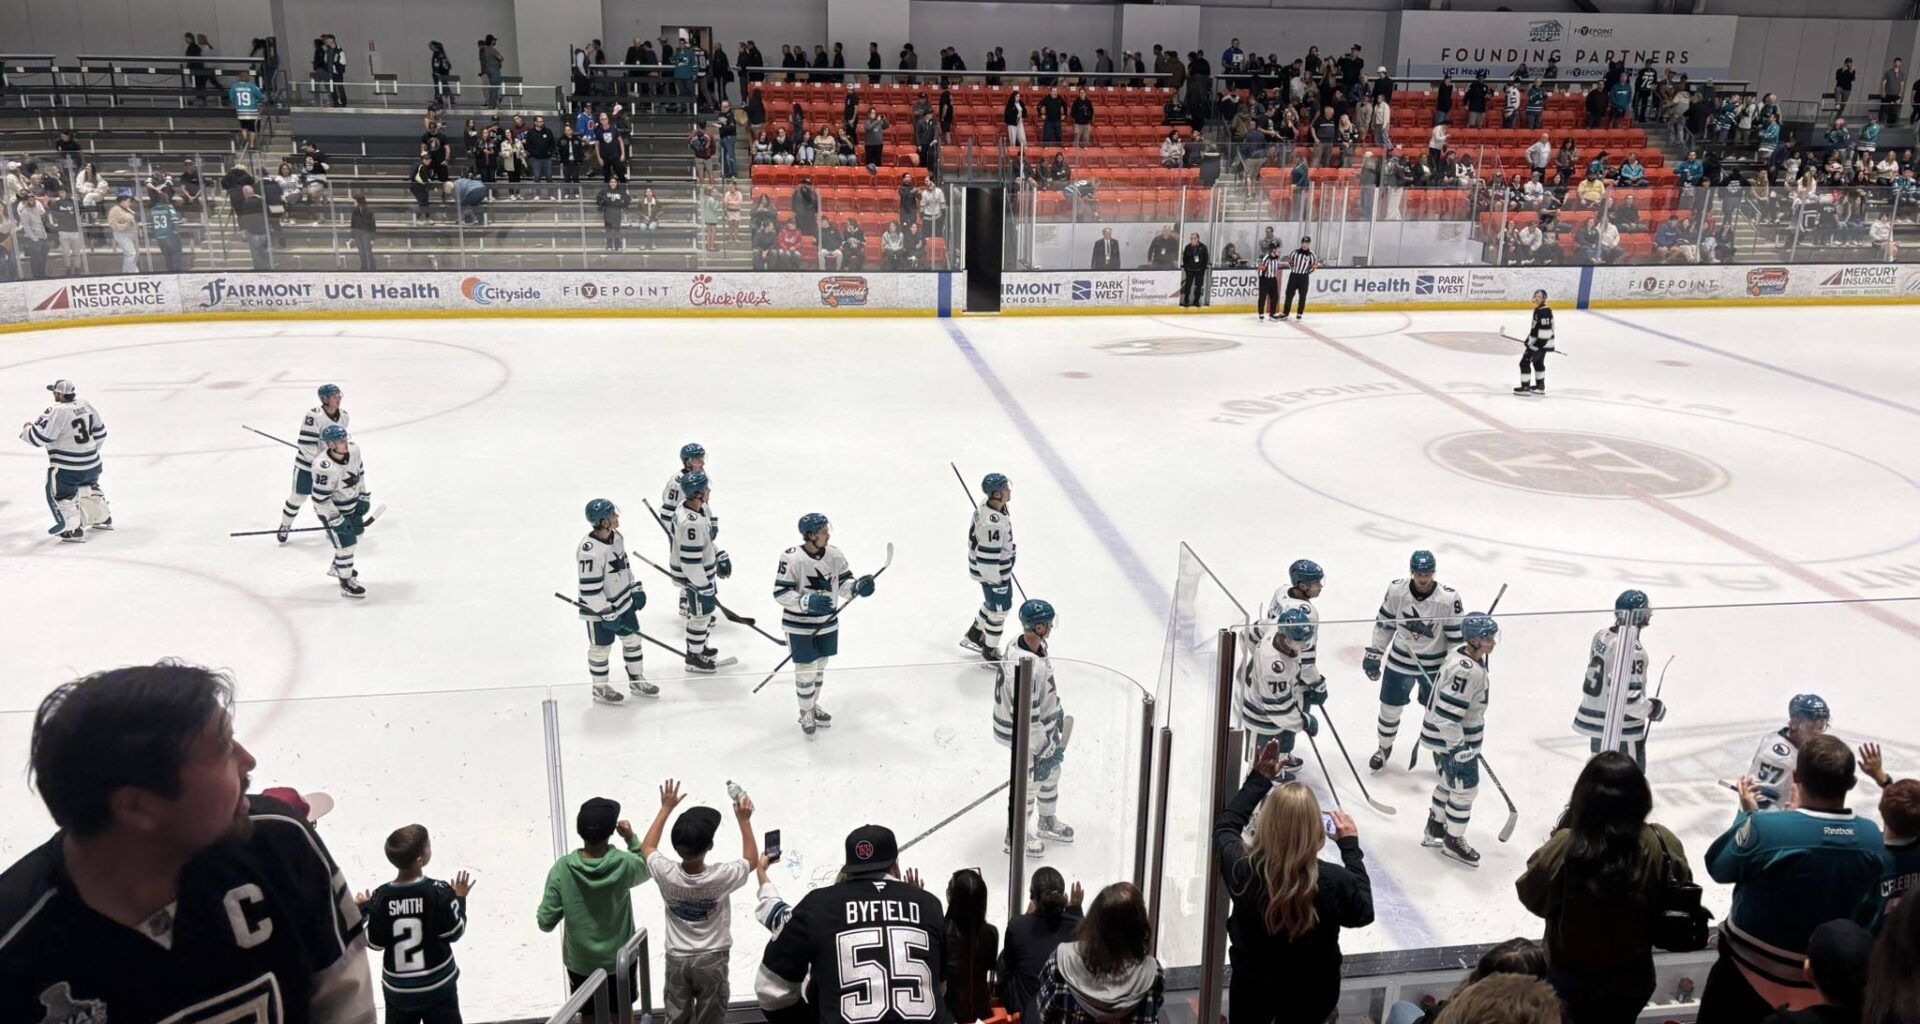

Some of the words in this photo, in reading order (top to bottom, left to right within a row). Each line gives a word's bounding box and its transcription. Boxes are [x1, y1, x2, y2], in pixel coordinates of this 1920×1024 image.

[1441, 47, 1562, 64] FOUNDING
[1576, 49, 1690, 64] PARTNERS
[1442, 67, 1458, 75] UCI
[1641, 76, 1654, 88] 72
[236, 92, 251, 106] 19
[153, 215, 168, 229] 53
[1472, 273, 1494, 281] Shaping
[1843, 266, 1898, 277] MERCURY
[1095, 280, 1123, 290] PARK
[1131, 278, 1155, 286] Shaping
[1211, 276, 1259, 288] ERCUR
[1315, 279, 1347, 293] UCI
[1354, 277, 1410, 293] Health
[1437, 275, 1465, 285] PARK
[1628, 277, 1715, 291] FIVEPOINT
[1842, 275, 1897, 286] INSURANCE
[71, 281, 162, 297] MERCURY
[200, 278, 312, 308] FAIRMONT
[324, 284, 363, 299] UCI
[371, 283, 440, 299] Health
[485, 287, 541, 302] Cityside
[563, 282, 669, 299] FIVEPOINT
[1000, 283, 1061, 295] IRMONT
[1095, 290, 1124, 300] WEST
[1210, 287, 1258, 297] SURANC
[1437, 284, 1466, 294] WEST
[72, 291, 166, 309] INSURANCE
[240, 298, 299, 306] SCHOOLS
[1208, 382, 1402, 426] FIVEPOINT
[687, 528, 696, 541] 6
[987, 529, 1000, 542] 14
[579, 559, 593, 573] 77
[1268, 680, 1287, 694] 70
[1451, 676, 1467, 694] 51
[1758, 761, 1785, 785] 57
[1823, 826, 1855, 836] Reebok
[388, 897, 424, 916] SMITH
[845, 900, 920, 924] BYFIELD
[223, 882, 273, 949] C
[393, 917, 425, 972] 2
[836, 926, 937, 1024] 55
